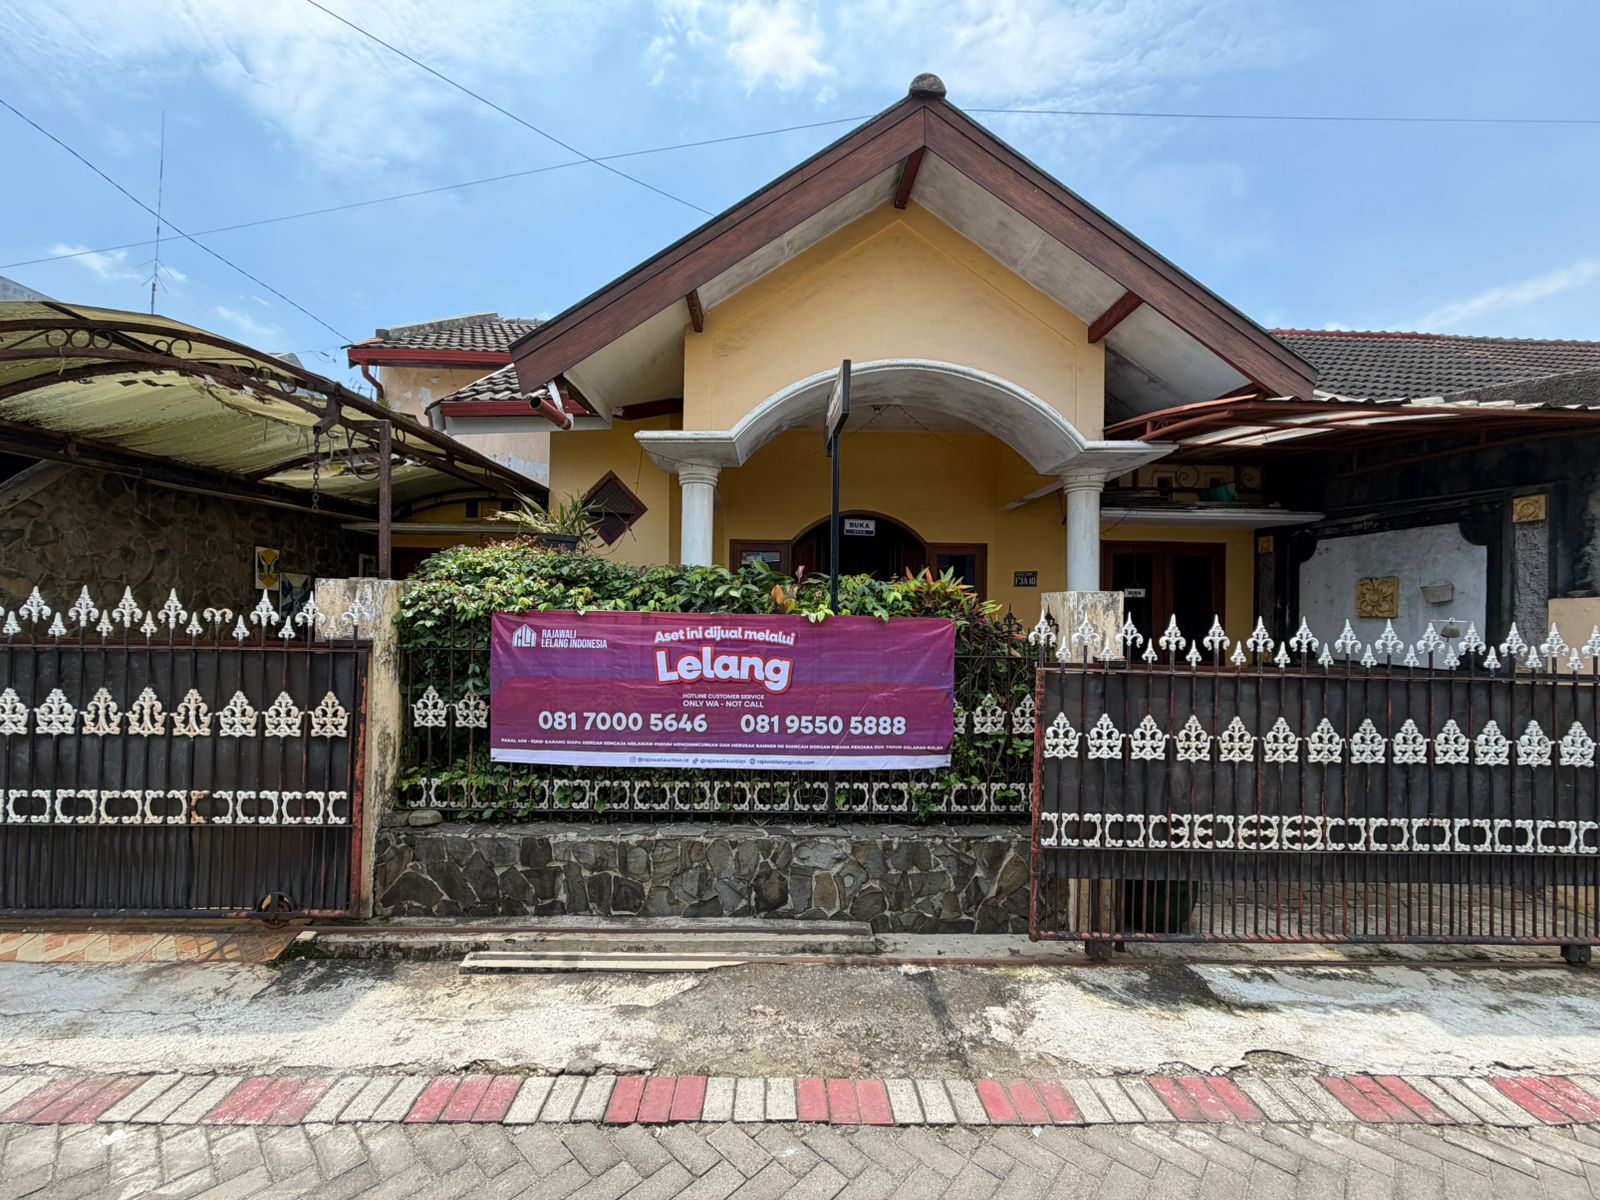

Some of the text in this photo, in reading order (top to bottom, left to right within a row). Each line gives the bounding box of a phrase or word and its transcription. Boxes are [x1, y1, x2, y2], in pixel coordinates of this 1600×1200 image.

[849, 521, 870, 529] BUKA
[541, 629, 577, 639] RAJAWALI
[654, 626, 796, 645] Aset ini dijual melalui
[541, 638, 608, 649] LELANG INDONESIA
[655, 646, 791, 692] Lelang
[682, 699, 704, 708] ONLY
[705, 700, 720, 708] WA
[726, 700, 744, 708] NOT
[745, 700, 765, 708] CALL
[538, 711, 708, 733] 081 7000 5646
[740, 714, 906, 736] 081 9550 5888
